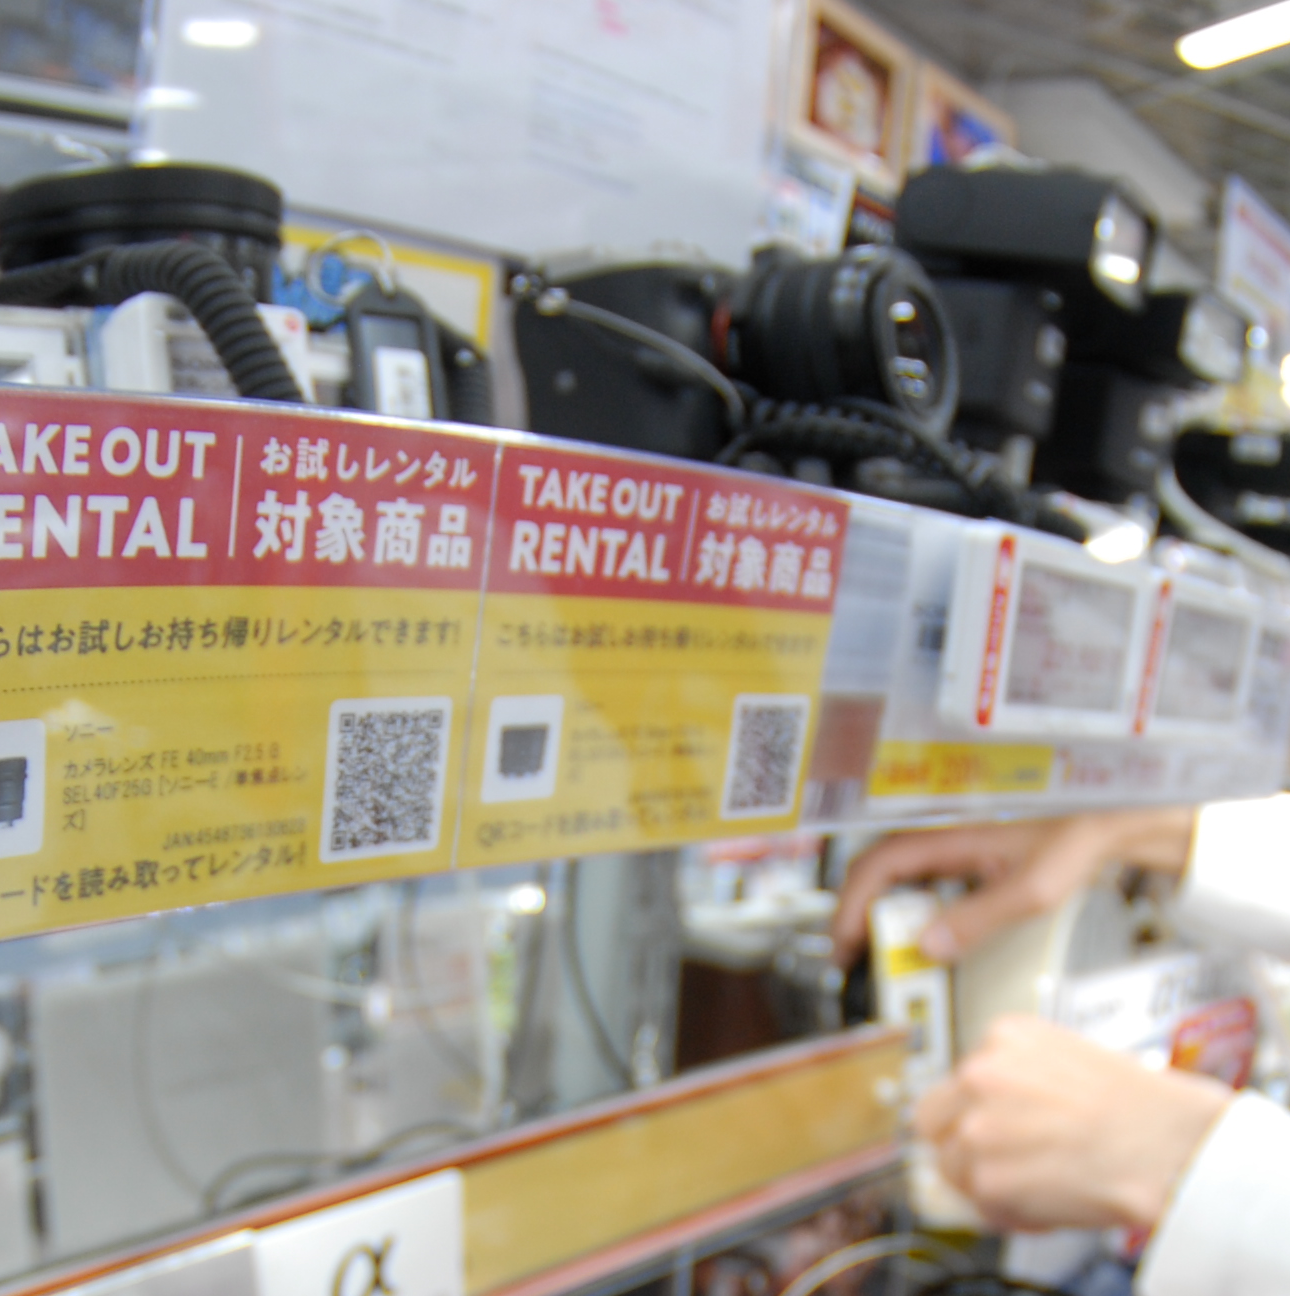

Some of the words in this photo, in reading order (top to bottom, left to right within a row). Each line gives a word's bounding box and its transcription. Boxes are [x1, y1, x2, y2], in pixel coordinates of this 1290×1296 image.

[99, 426, 216, 479] OUT
[258, 436, 478, 489] お試しレンタル
[518, 464, 609, 514] TAKE
[612, 478, 684, 522] OUT
[705, 490, 840, 539] お試しレンタル
[252, 489, 474, 569] 対象商品
[509, 519, 671, 583] RENTAL
[695, 530, 833, 600] 対象商品
